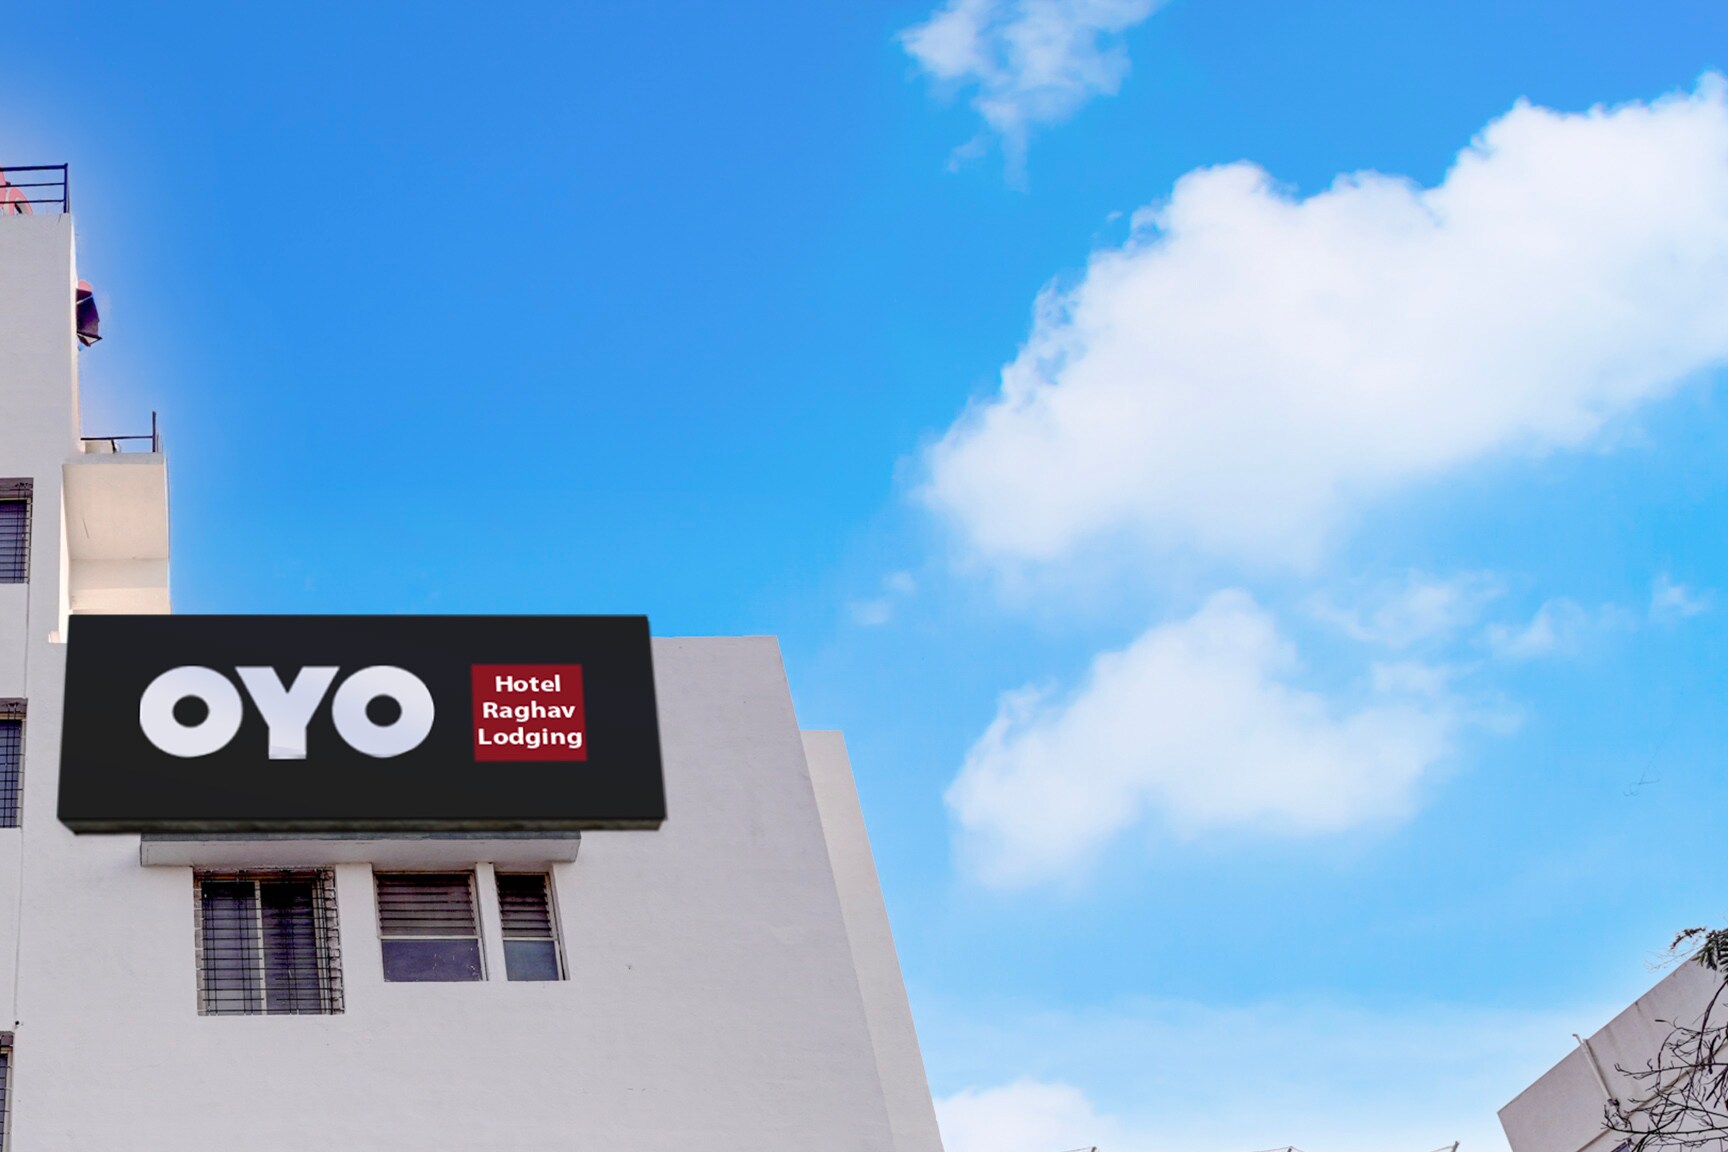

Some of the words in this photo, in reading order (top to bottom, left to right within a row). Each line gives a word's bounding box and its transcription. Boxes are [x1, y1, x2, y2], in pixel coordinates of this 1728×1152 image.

[495, 674, 561, 693] Hotel
[139, 665, 435, 760] OYO
[482, 701, 576, 723] Raghav
[478, 727, 583, 749] Lodging
